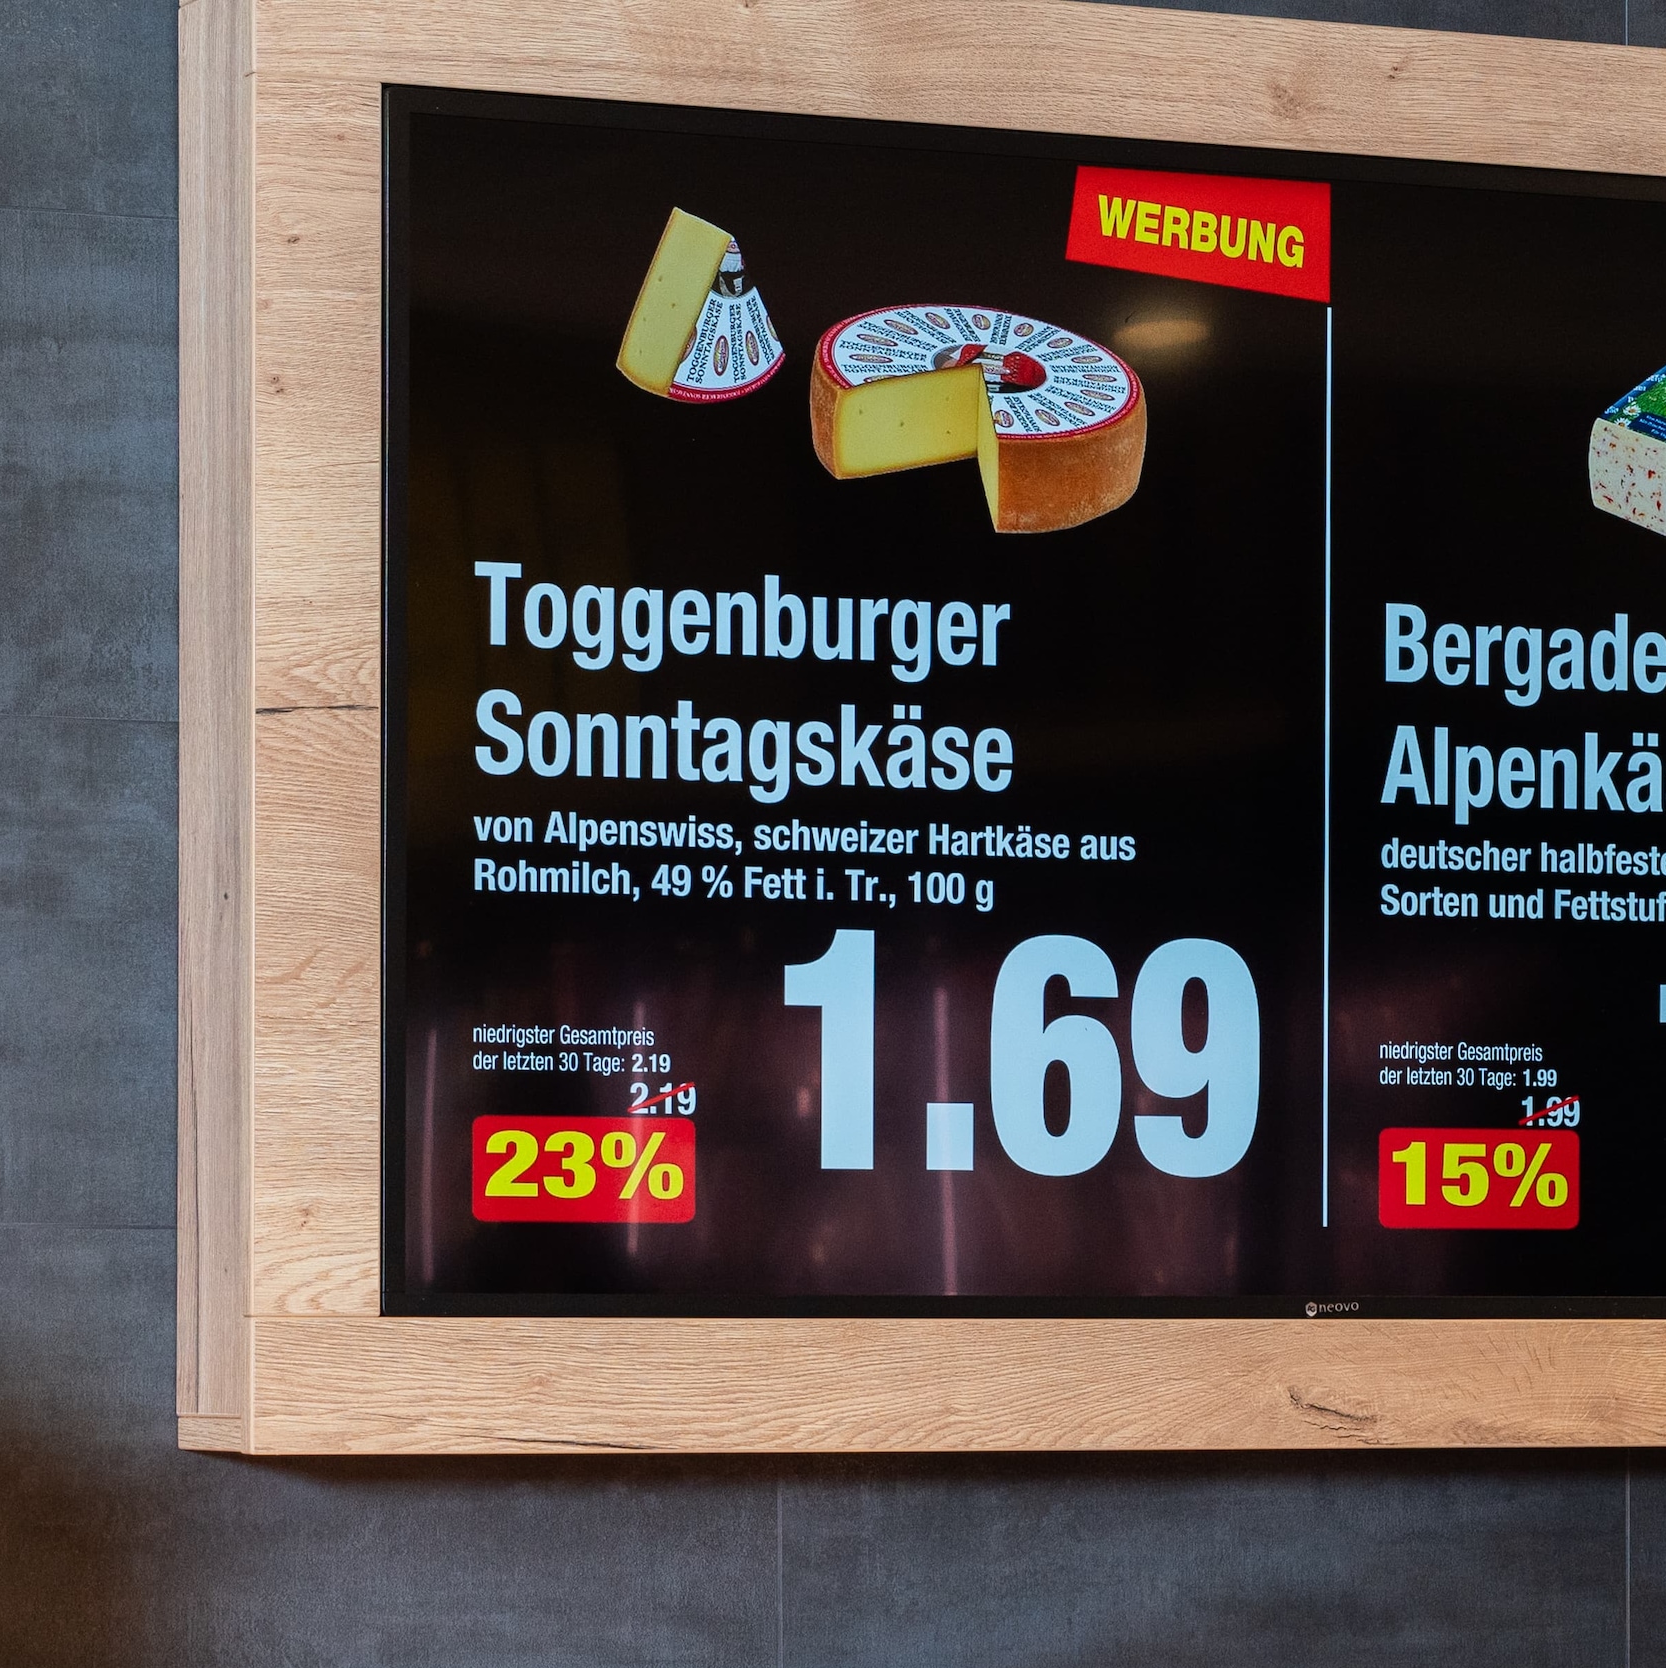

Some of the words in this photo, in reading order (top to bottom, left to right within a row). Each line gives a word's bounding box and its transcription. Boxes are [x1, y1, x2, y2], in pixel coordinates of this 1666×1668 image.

[1098, 194, 1305, 269] WERBUNG
[687, 299, 717, 382] TOGGENBURGER
[475, 562, 1010, 684] Toggenburger
[475, 690, 1013, 804] Sonntagskäse
[473, 815, 533, 843] von
[544, 811, 743, 855] Alpenswiss,
[753, 818, 919, 854] schweizer
[928, 823, 1070, 859] Hartkäse
[1080, 835, 1137, 861] aus
[1380, 837, 1532, 872] deutscher
[474, 859, 640, 901] Rohmilch,
[651, 863, 692, 897] 49
[701, 864, 734, 898] %
[744, 866, 807, 900] Fett
[816, 867, 834, 901] i.
[844, 869, 896, 908] Tr.,
[907, 871, 966, 905] 100
[975, 879, 994, 912] g
[1380, 884, 1479, 918] Sorten
[1488, 888, 1544, 920] und
[472, 1023, 556, 1049] niedrigster
[559, 1024, 655, 1050] Gesamtpreis
[783, 928, 1261, 1178] 1.69
[1379, 1040, 1454, 1064] niedrigster
[1457, 1041, 1543, 1065] Gesamtpreis
[472, 1050, 498, 1071] der
[503, 1050, 554, 1071] letzten
[558, 1051, 579, 1072] 30
[582, 1052, 625, 1076] Tage:
[631, 1053, 671, 1074] 2.19
[1379, 1066, 1403, 1085] der
[1406, 1066, 1452, 1086] letzten
[1456, 1067, 1475, 1087] 30
[1478, 1067, 1517, 1090] Tage:
[1522, 1068, 1558, 1088] 1.99
[629, 1081, 697, 1116] 2.19
[1521, 1095, 1580, 1128] 1.99
[484, 1129, 684, 1200] 23%
[1392, 1141, 1569, 1208] 15%
[1318, 1301, 1360, 1313] neovo
